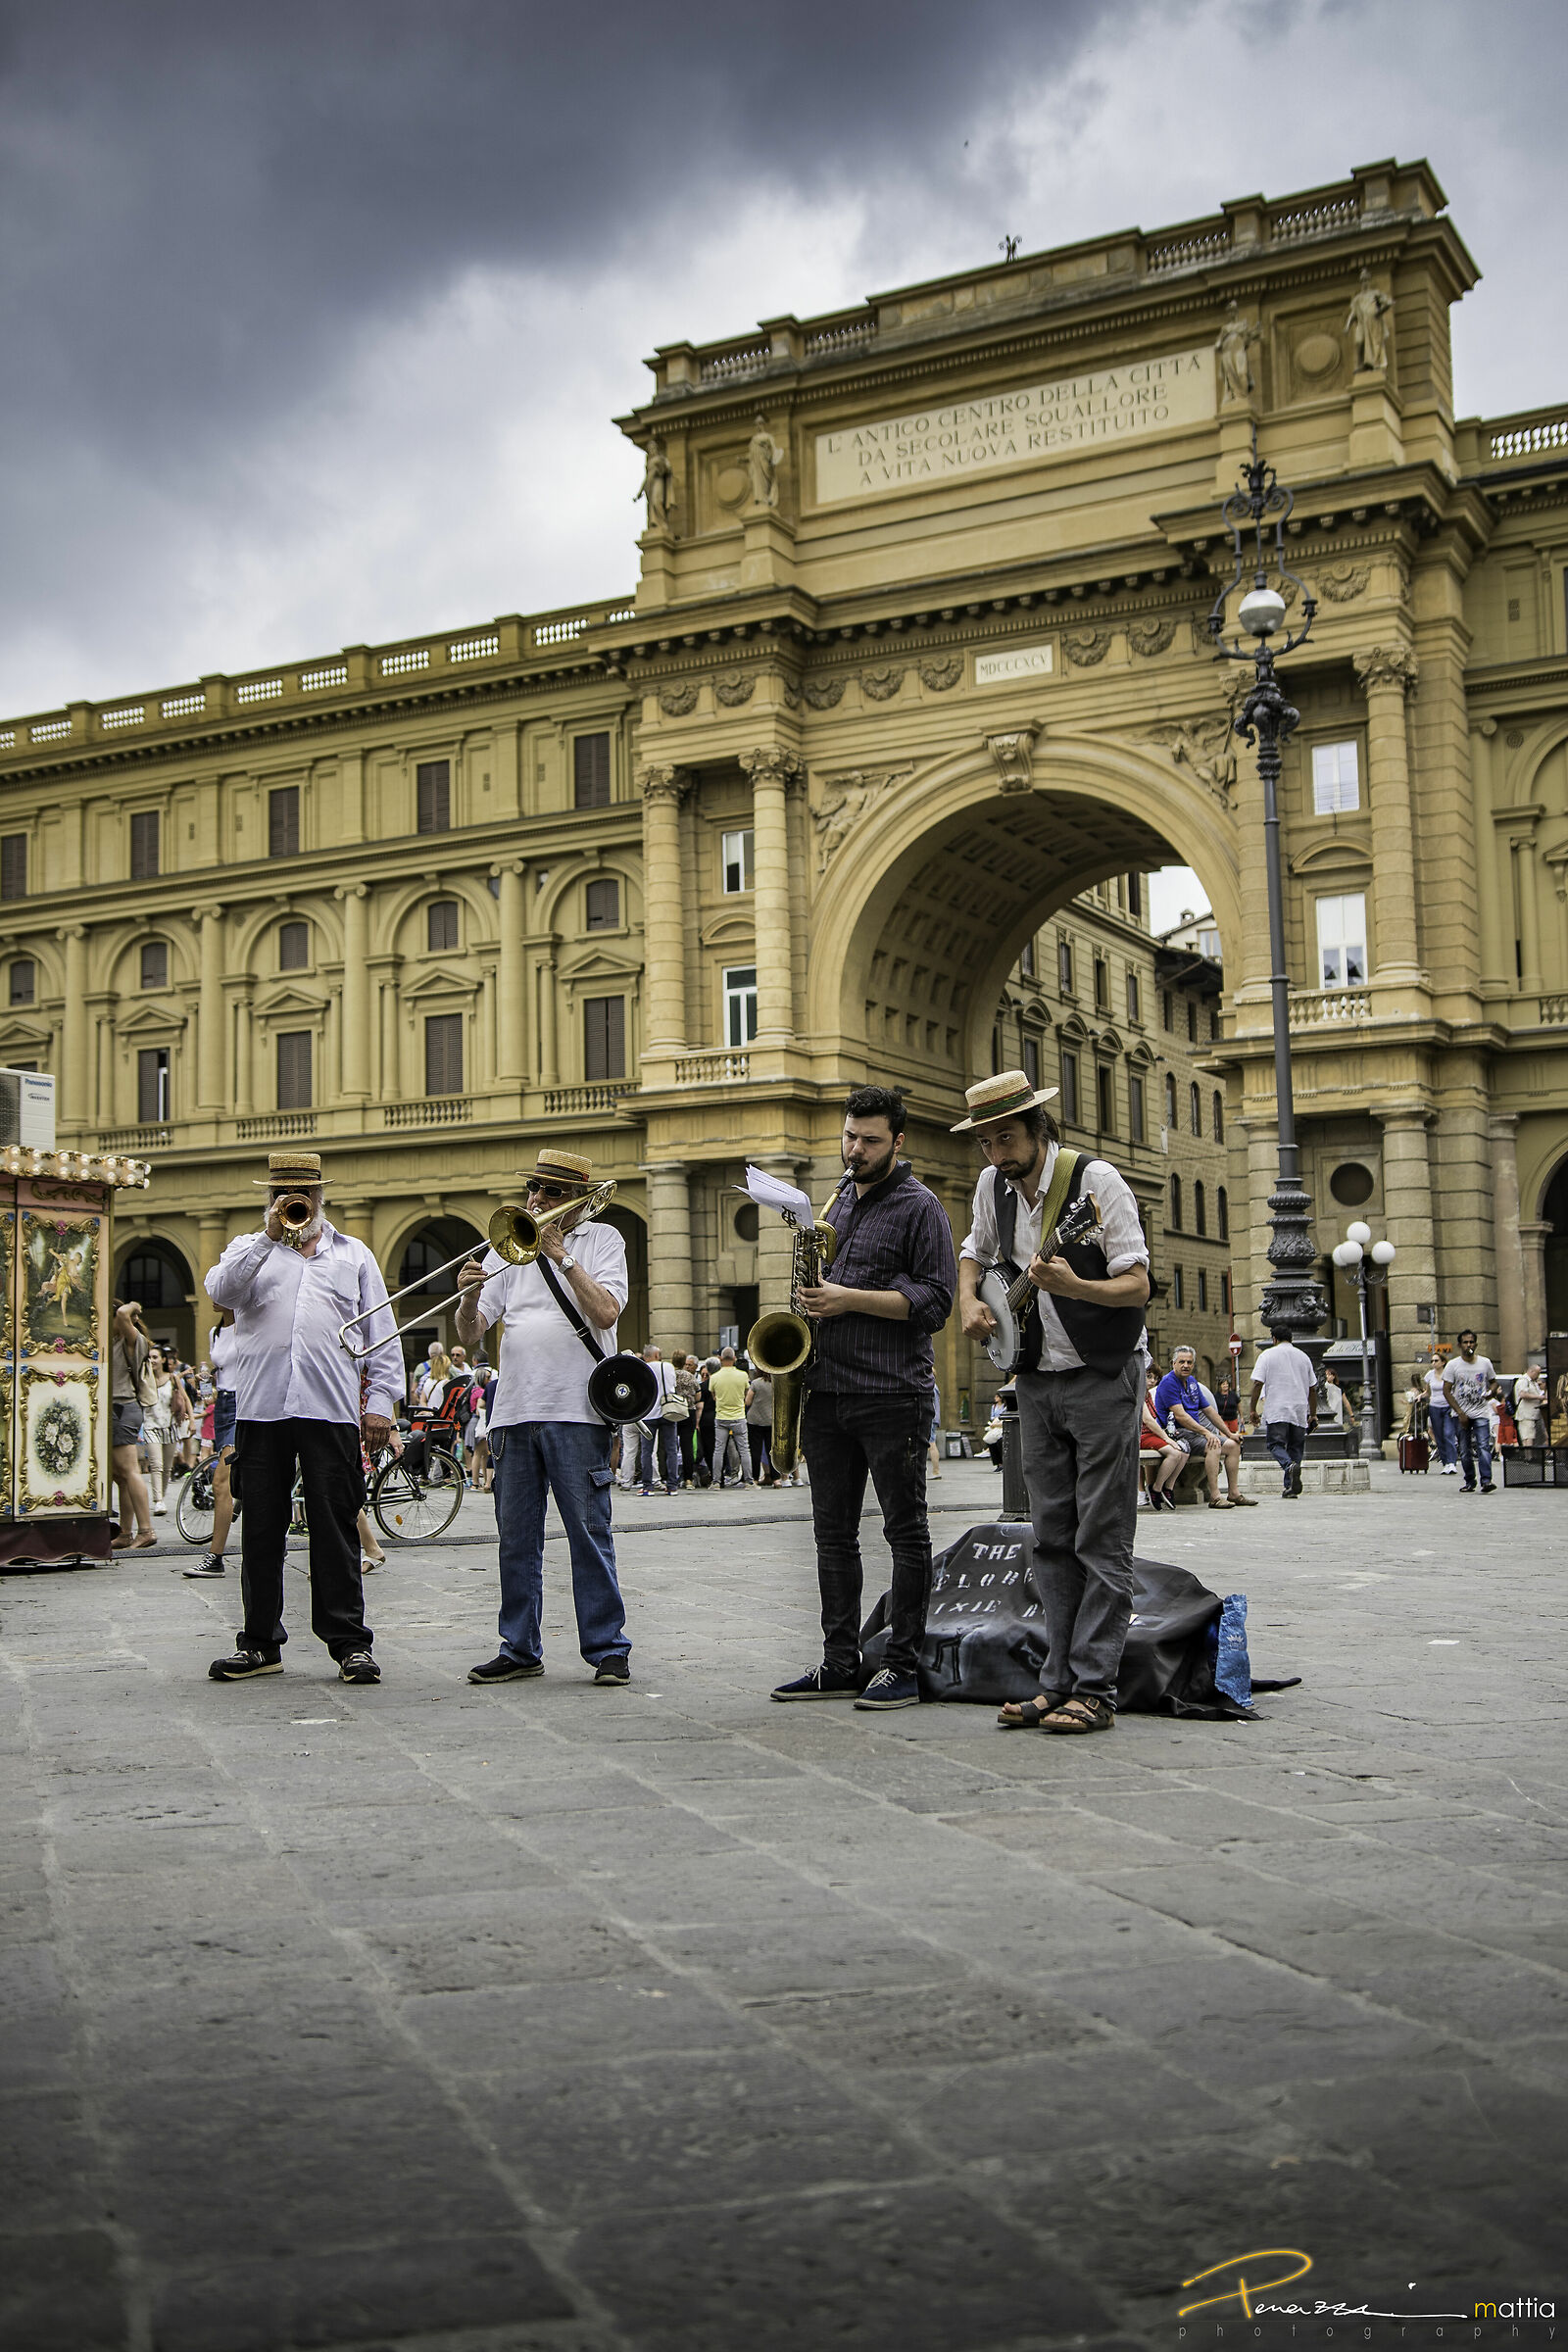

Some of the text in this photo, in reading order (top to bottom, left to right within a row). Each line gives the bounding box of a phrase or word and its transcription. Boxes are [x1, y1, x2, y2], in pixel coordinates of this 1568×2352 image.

[852, 417, 930, 448] ANTICO
[938, 395, 1030, 427] CENTRO
[1041, 374, 1118, 406] DELLA
[858, 384, 1167, 466] DA SECOLARE SQUALLORE
[859, 404, 1169, 486] A VITA NUOVA RESTITUITO
[972, 1543, 1022, 1560] THE
[933, 1599, 1002, 1615] IXIE
